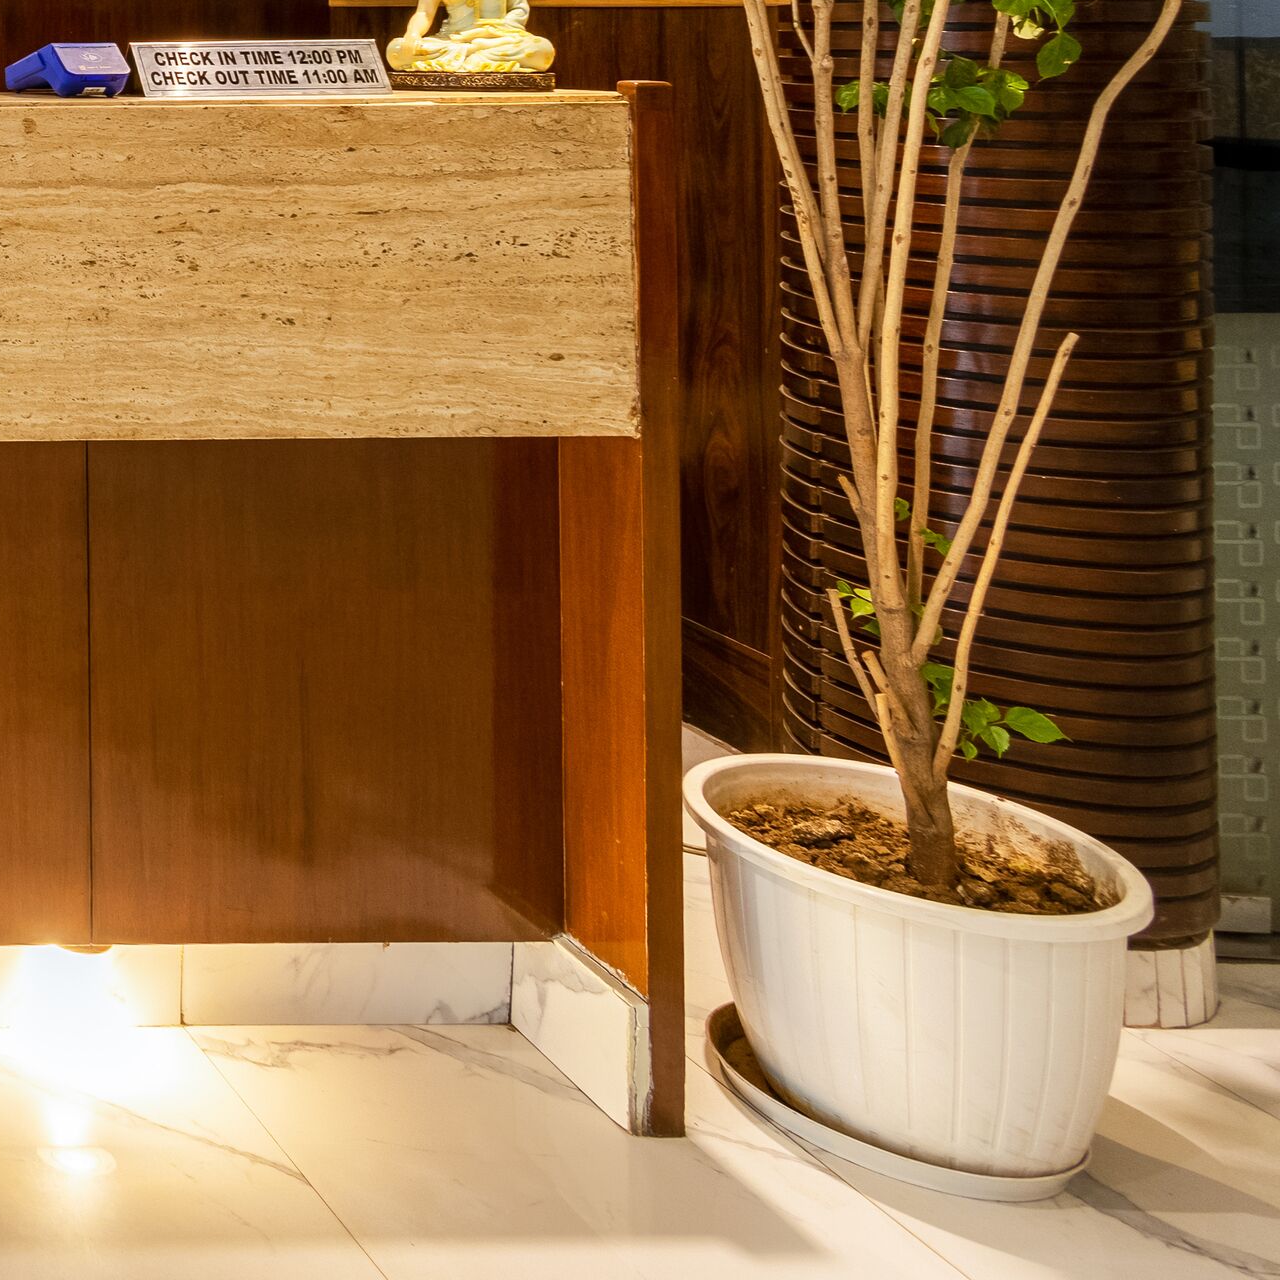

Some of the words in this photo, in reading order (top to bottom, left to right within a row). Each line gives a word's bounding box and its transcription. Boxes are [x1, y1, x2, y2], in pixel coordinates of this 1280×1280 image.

[154, 52, 215, 66] CHECK
[218, 51, 236, 65] IN
[241, 50, 284, 65] TIME
[288, 50, 332, 64] 12:00
[339, 50, 363, 64] PM
[151, 71, 211, 85] CHECK
[215, 71, 249, 85] OUT
[254, 70, 298, 84] TIME
[302, 70, 347, 84] 11:00
[353, 69, 379, 83] AM
